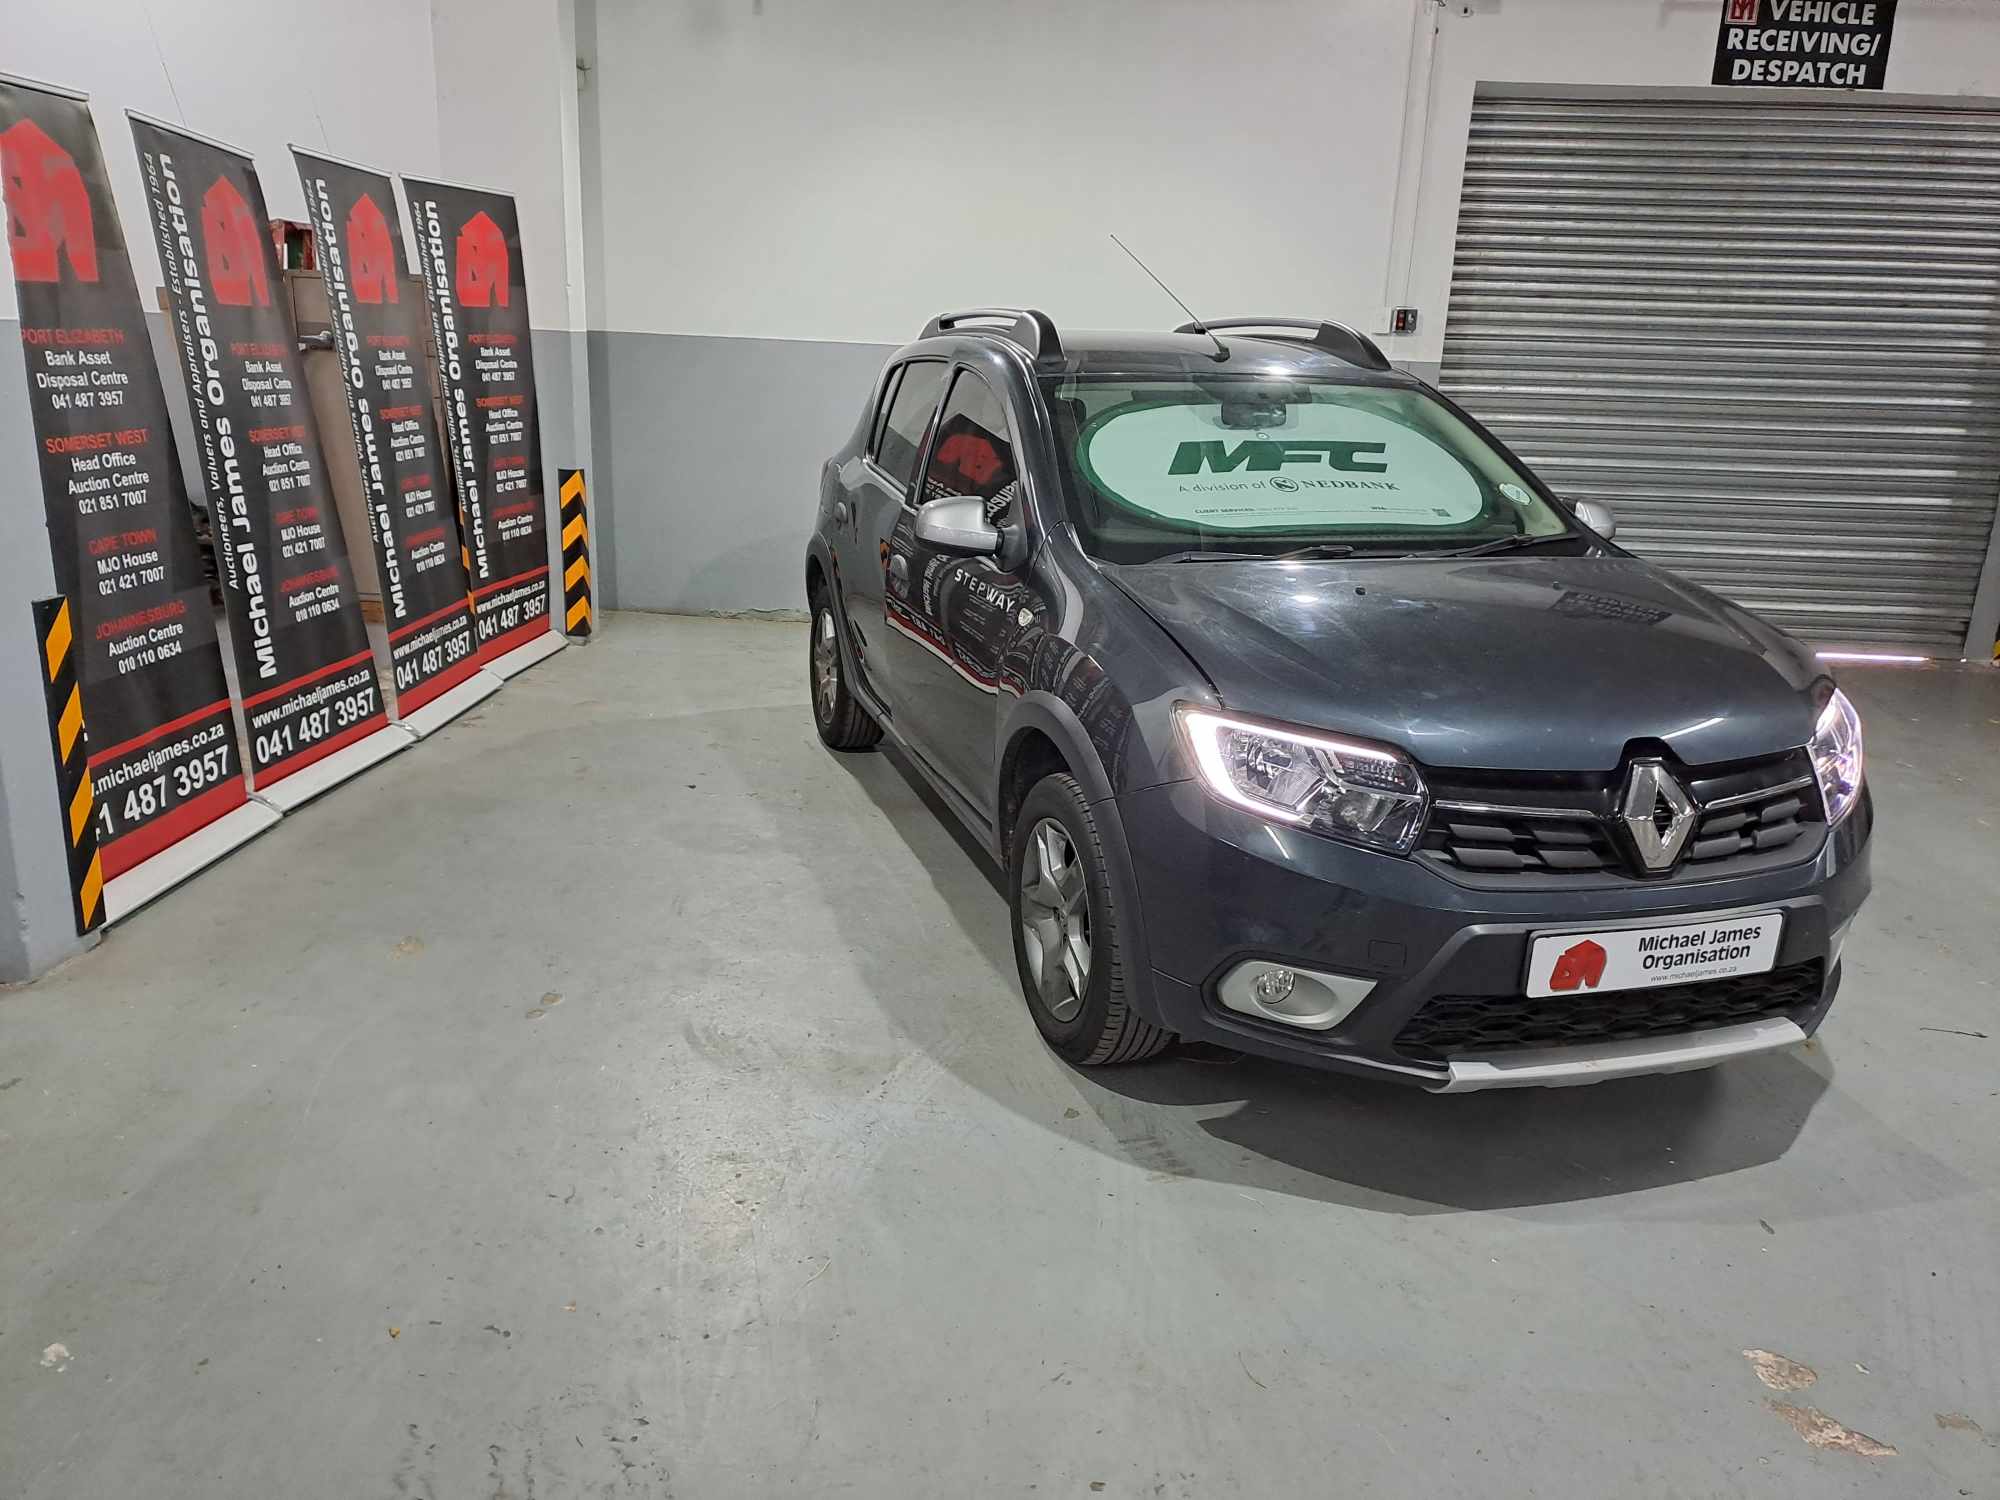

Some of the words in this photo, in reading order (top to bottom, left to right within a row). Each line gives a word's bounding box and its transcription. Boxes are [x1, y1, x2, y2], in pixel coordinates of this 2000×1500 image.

[1770, 0, 1877, 25] VEHICLE
[1727, 28, 1882, 56] RECEIVING/
[1731, 58, 1867, 85] DESPATCH
[153, 198, 182, 295] Established
[159, 153, 225, 406] Organisation
[315, 178, 364, 389] Organisation
[425, 200, 461, 381] Organisation
[45, 350, 76, 366] Bank
[78, 350, 112, 365] Asset
[178, 308, 203, 395] Appraisers
[36, 371, 88, 391] Disposal
[91, 370, 129, 386] Centre
[51, 393, 72, 409] 041
[75, 391, 95, 408] 487
[99, 390, 124, 407] 3957
[194, 397, 209, 430] and
[454, 388, 475, 473] James
[45, 432, 112, 454] SOMERSET
[115, 428, 148, 445] WEST
[358, 398, 385, 496] James
[1167, 440, 1388, 475] MFC
[71, 454, 100, 473] Head
[102, 452, 136, 468] Office
[203, 433, 221, 490] Valuers
[216, 416, 250, 533] James
[68, 476, 111, 495] Auction
[112, 471, 150, 487] Centre
[78, 498, 97, 515] 021
[99, 493, 120, 511] 851
[122, 489, 148, 507] 7007
[1192, 481, 1249, 493] division
[1252, 480, 1267, 489] of
[1301, 480, 1401, 491] NEDBANK
[215, 496, 239, 590] Auctioneers,
[299, 523, 321, 539] House
[465, 479, 489, 579] Michael
[97, 556, 120, 575] MJO
[122, 550, 159, 569] House
[99, 579, 117, 596] 021
[119, 573, 138, 590] 421
[140, 566, 165, 584] 7007
[375, 503, 407, 619] Michael
[236, 542, 277, 679] Michael
[954, 568, 1016, 613] STEPWAY
[478, 612, 498, 640] 041
[501, 604, 519, 630] 487
[523, 593, 546, 621] 3957
[108, 633, 147, 657] Auction
[149, 622, 184, 642] Centre
[118, 657, 136, 675] 010
[137, 649, 156, 667] 110
[157, 640, 183, 660] 0634
[396, 658, 420, 690] 041
[422, 645, 443, 676] 487
[446, 630, 471, 664] 3957
[252, 669, 370, 729] www.michaeljames.co.za
[255, 724, 293, 764] 041
[298, 707, 330, 743] 487
[335, 687, 374, 727] 3957
[92, 723, 225, 797] .michaeljames.co.za
[123, 775, 167, 822] 487
[173, 744, 229, 797] 3957
[1639, 930, 1706, 952] Michael
[1709, 926, 1762, 945] James
[1642, 945, 1751, 970] Organisation
